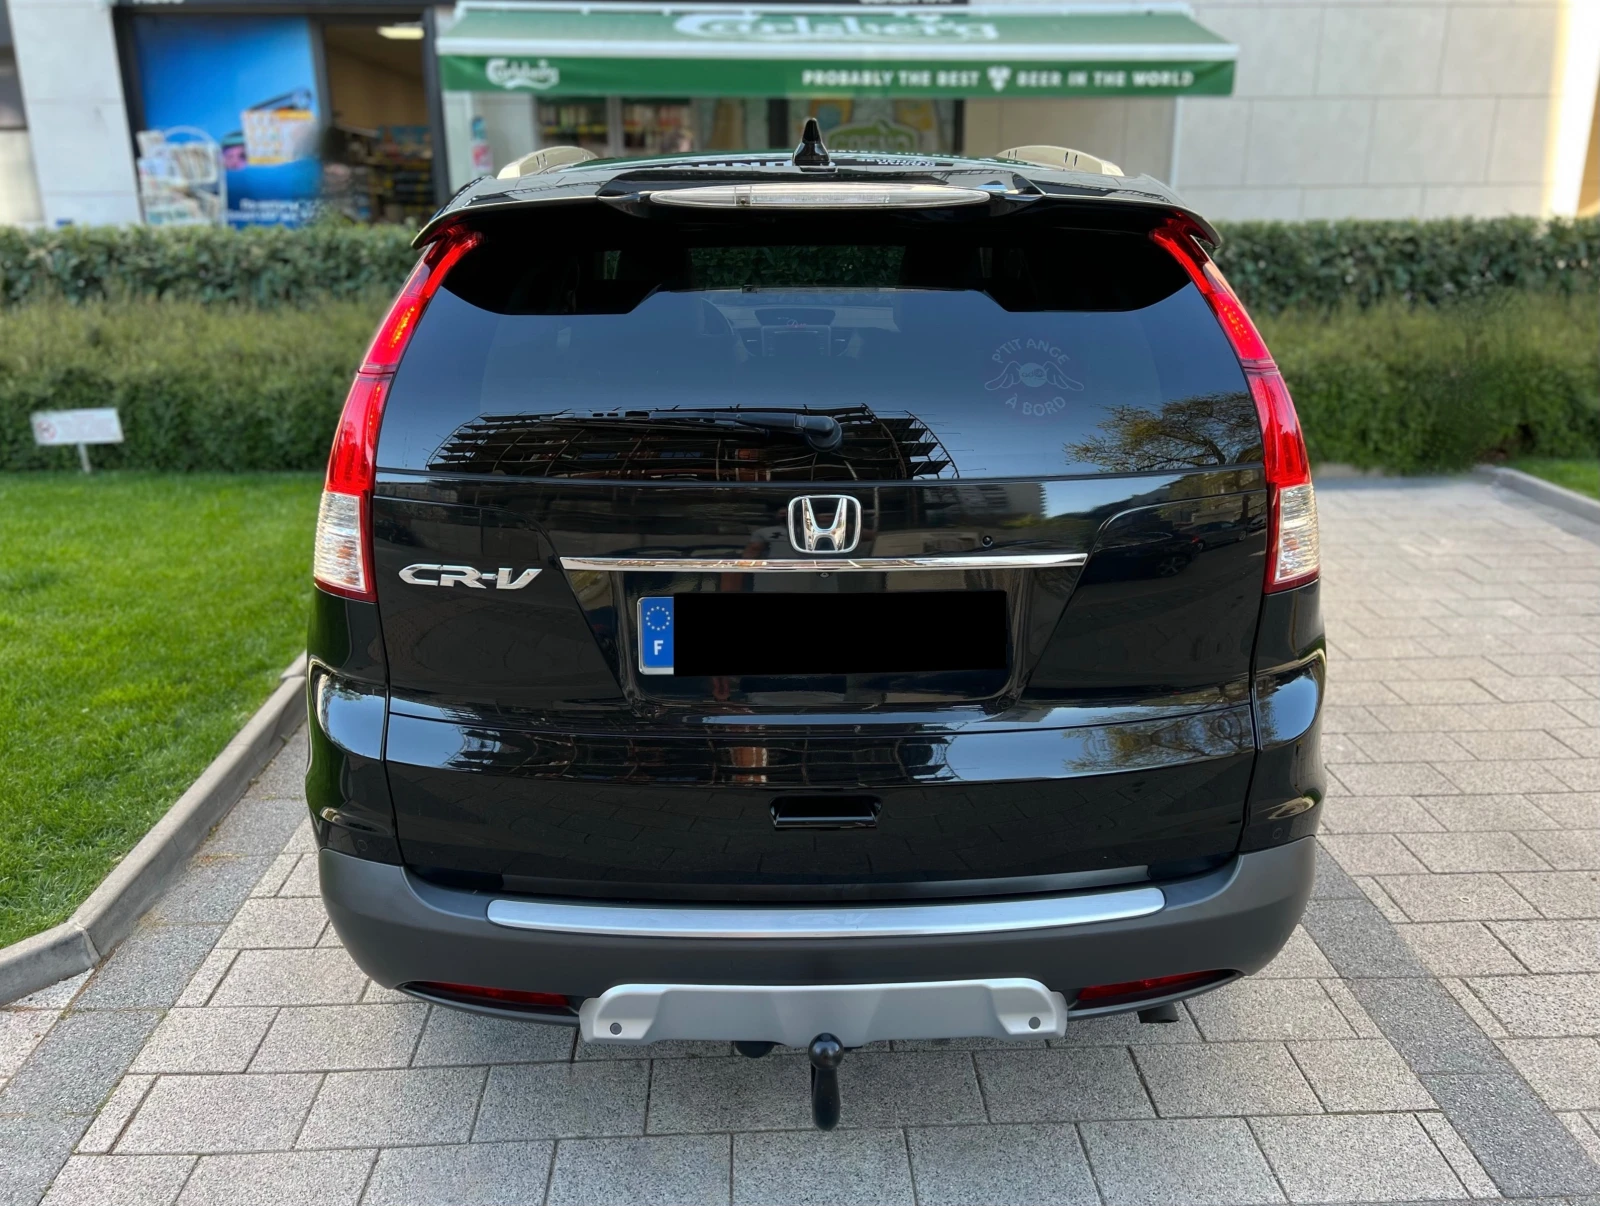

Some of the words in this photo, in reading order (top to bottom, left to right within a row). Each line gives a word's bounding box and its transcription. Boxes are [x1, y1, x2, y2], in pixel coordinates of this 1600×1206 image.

[673, 12, 1000, 42] Carlsberg
[802, 69, 894, 87] PROBABLY
[897, 70, 932, 87] THE
[937, 70, 980, 87] BEST
[1016, 70, 1062, 88] BEER
[1068, 70, 1088, 87] IN
[1093, 70, 1127, 88] THE
[1132, 70, 1195, 88] WORLD
[1026, 338, 1071, 365] ANGE
[1022, 396, 1066, 417] BORD
[398, 563, 543, 590] CR-V
[653, 639, 664, 656] F
